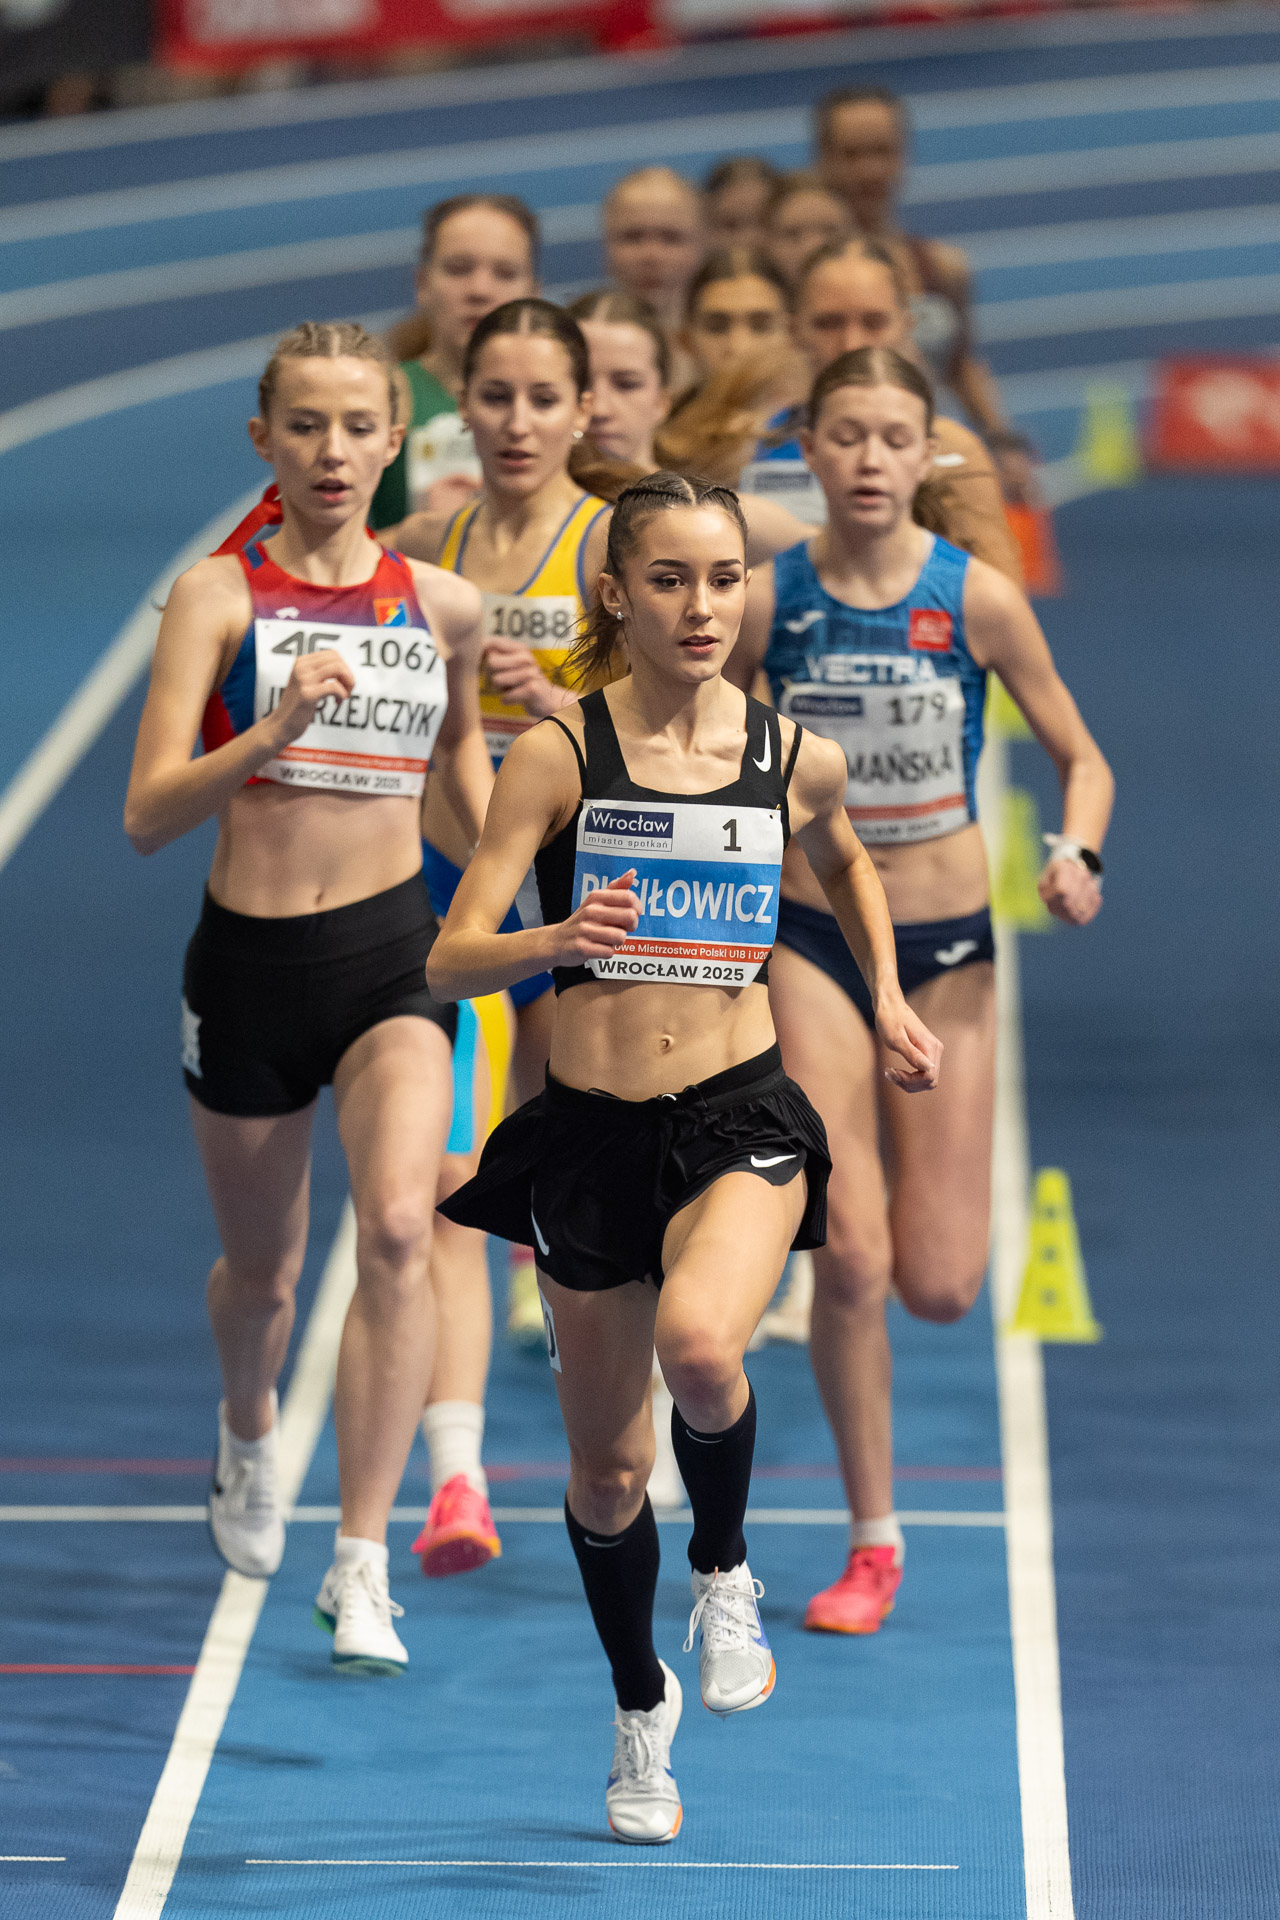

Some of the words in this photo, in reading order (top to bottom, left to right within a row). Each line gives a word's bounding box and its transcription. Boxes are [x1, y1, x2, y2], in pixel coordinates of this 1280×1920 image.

[492, 606, 571, 640] 1088
[359, 640, 438, 673] 1067
[804, 653, 938, 684] VECTRA
[262, 686, 437, 738] JRZEJCZYK
[887, 692, 947, 727] 179
[591, 810, 670, 833] Wrocław
[722, 818, 742, 852] 1
[588, 836, 624, 846] miasto
[627, 839, 668, 849] spotkań
[580, 872, 775, 925] PIŁOWICZ
[637, 941, 698, 956] Mistrzostwa
[699, 946, 727, 958] Polski
[729, 947, 746, 959] U18
[747, 949, 752, 960] i
[598, 960, 699, 980] WROCŁAW
[702, 965, 745, 982] 2025
